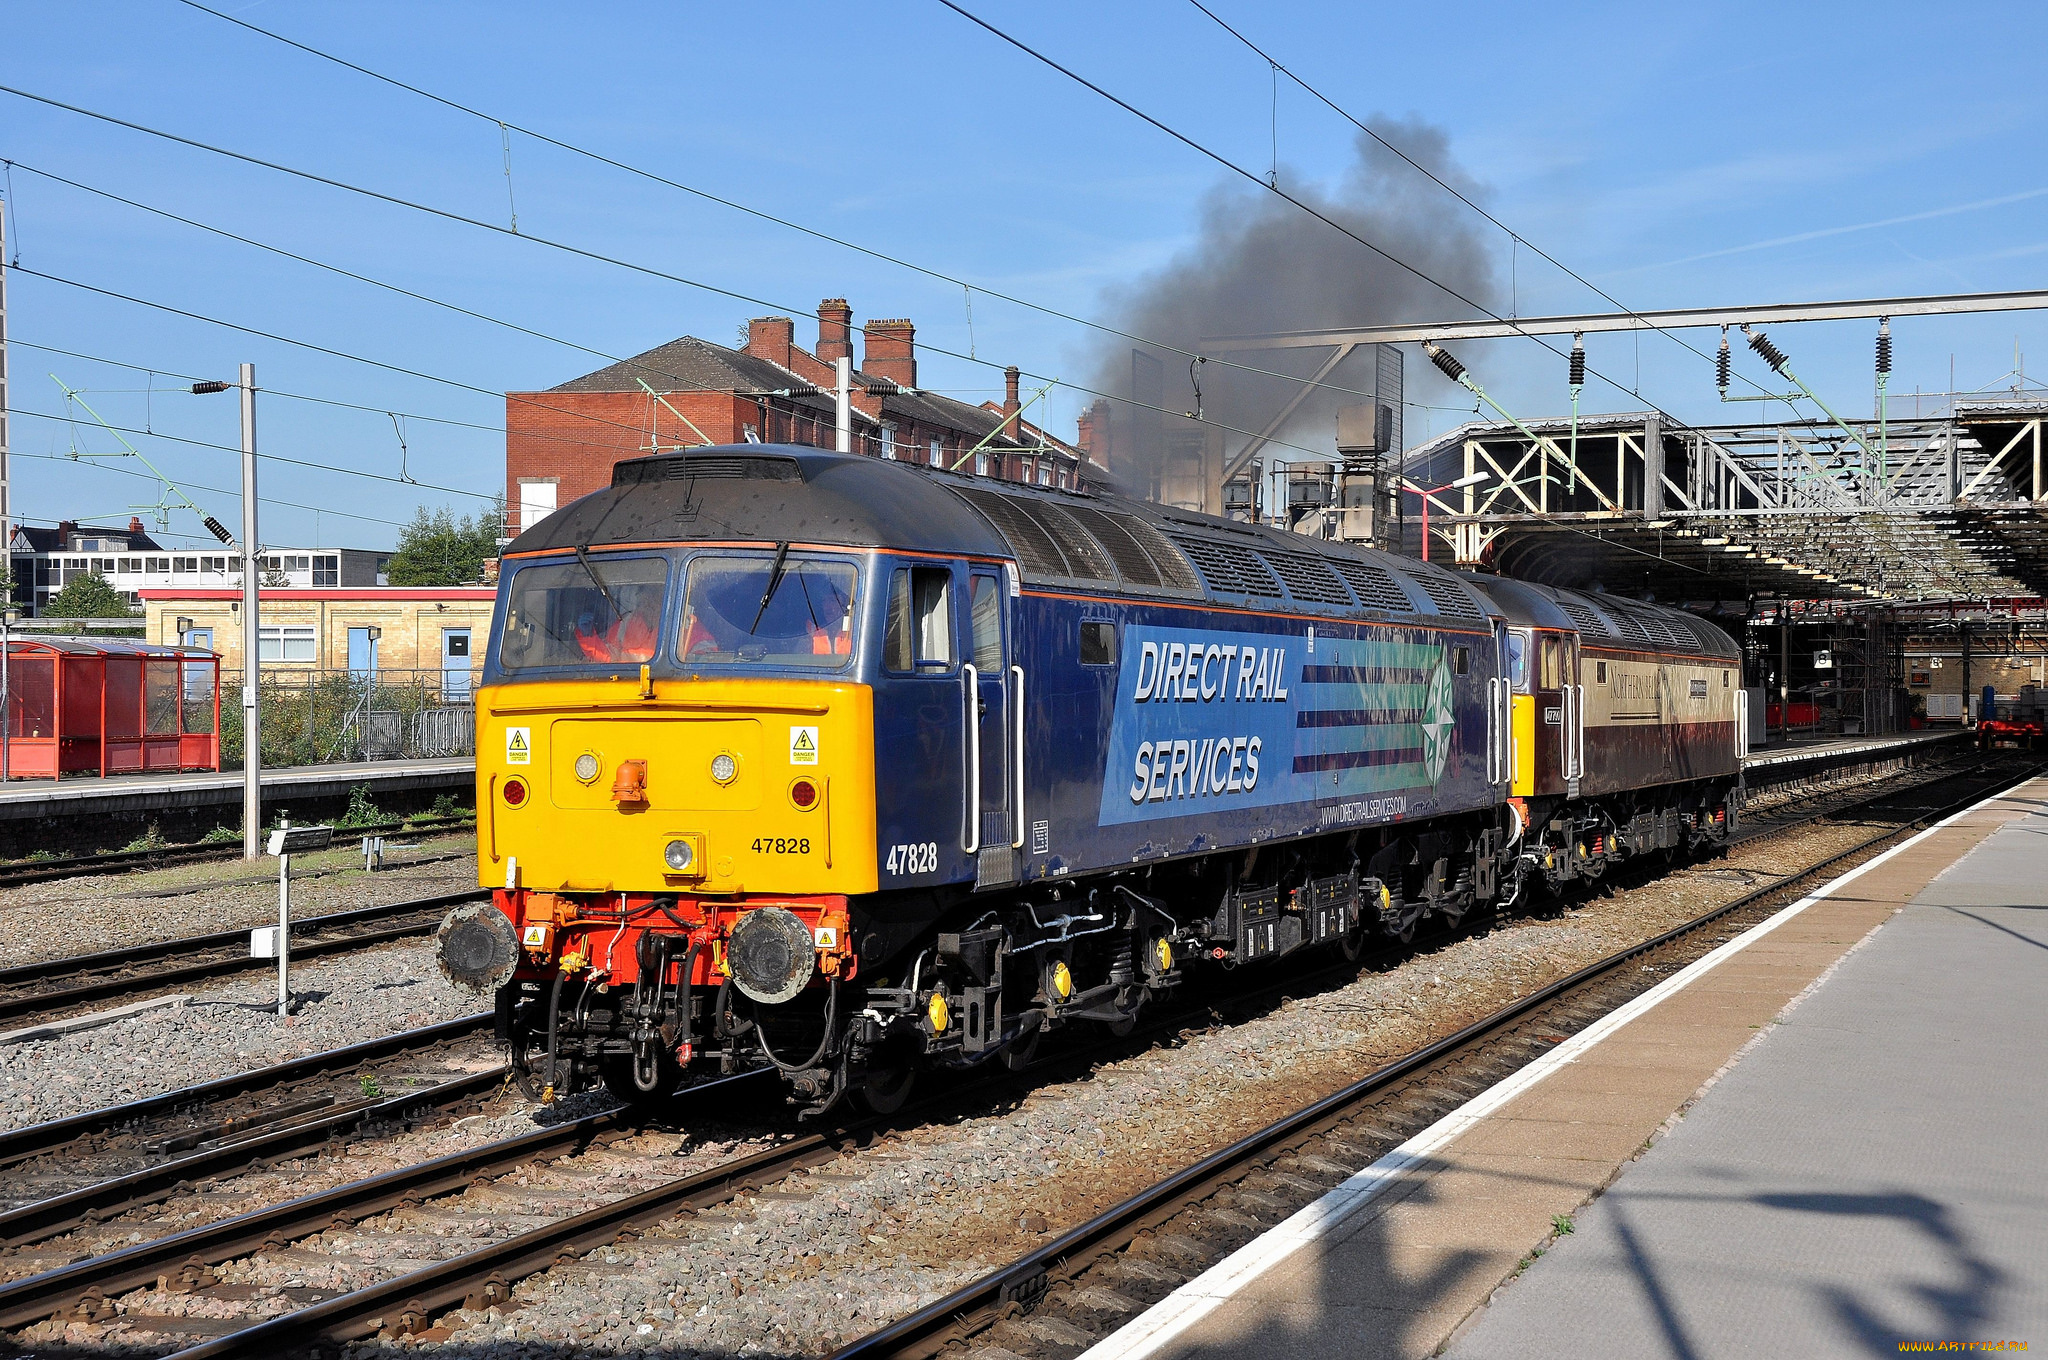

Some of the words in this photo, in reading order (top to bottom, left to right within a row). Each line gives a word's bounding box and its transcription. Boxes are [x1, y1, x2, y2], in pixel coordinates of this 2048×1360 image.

[1134, 641, 1238, 702] DIRECT
[1235, 646, 1288, 702] RAIL
[1818, 653, 1827, 665] 8
[1610, 665, 1644, 699] NORTHERN
[1130, 735, 1263, 803] SERVICES
[1321, 796, 1407, 825] WWW.DIRECTRAILSERVICES.COM
[751, 838, 811, 854] 47828
[886, 842, 938, 876] 47828
